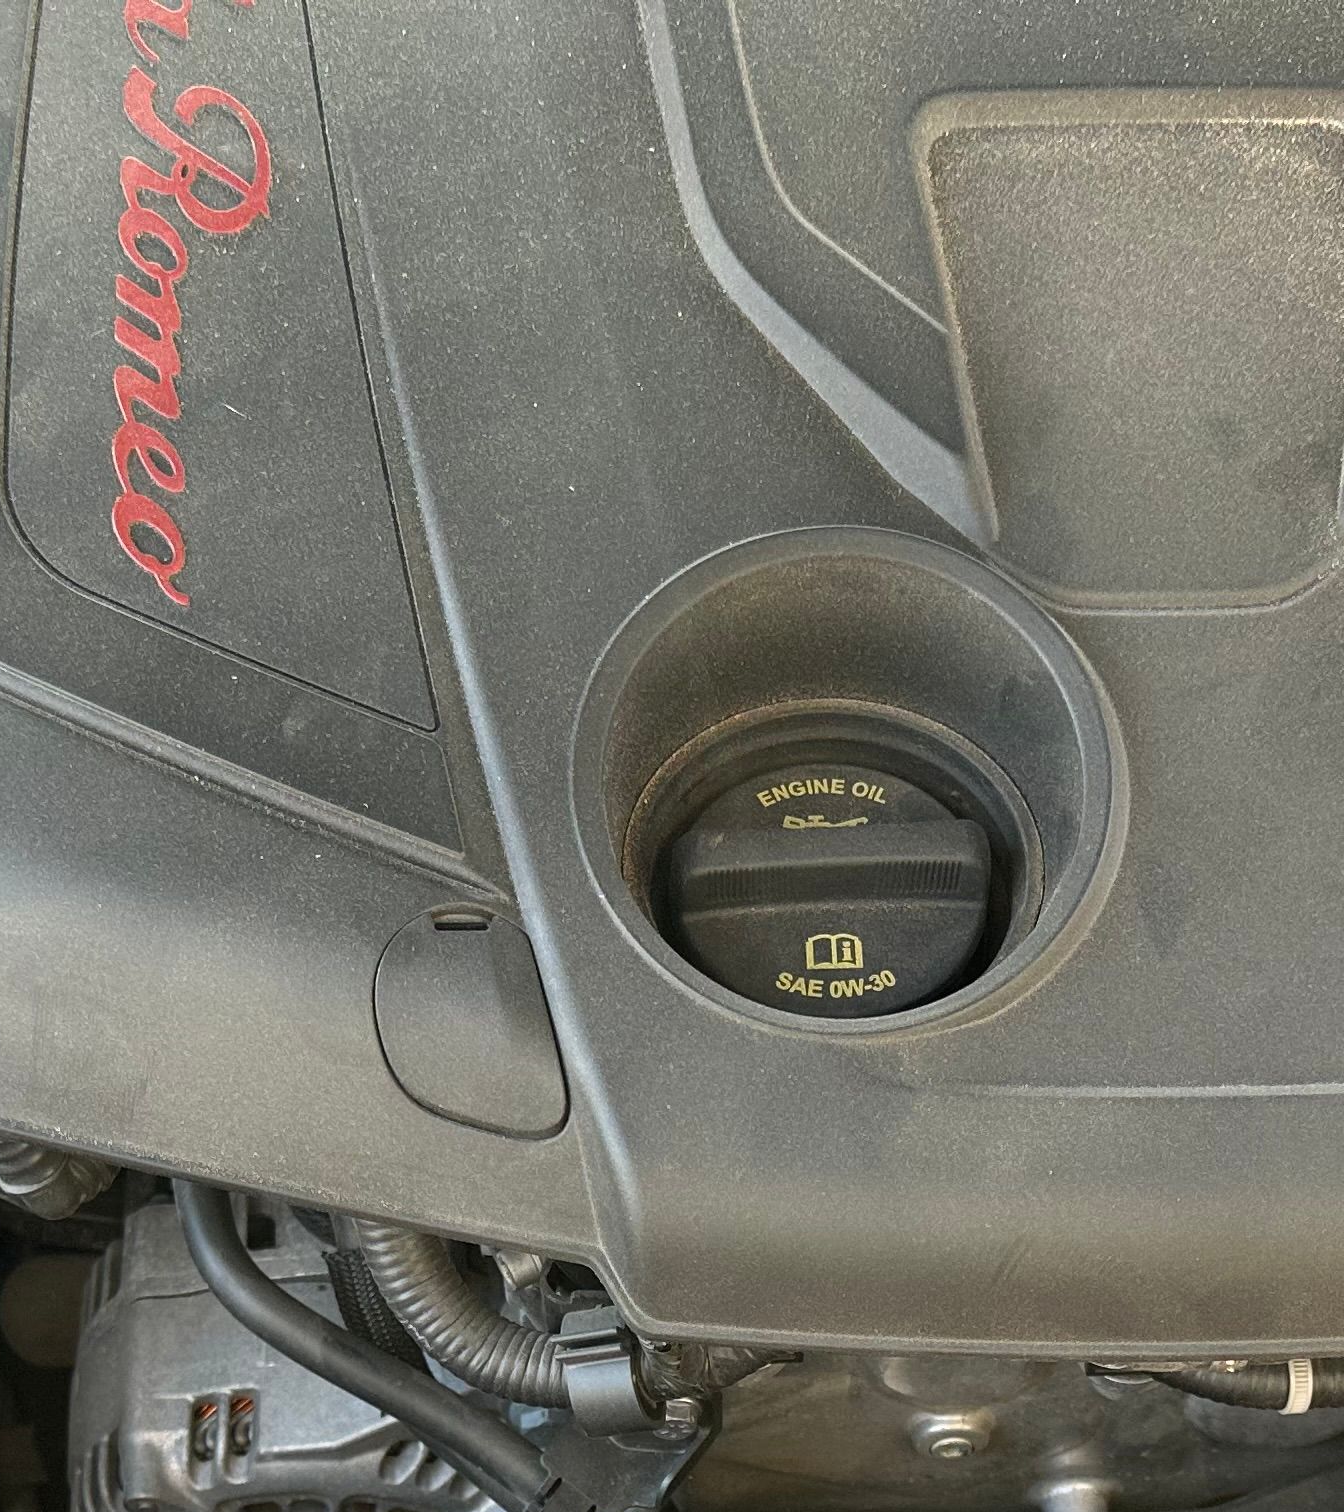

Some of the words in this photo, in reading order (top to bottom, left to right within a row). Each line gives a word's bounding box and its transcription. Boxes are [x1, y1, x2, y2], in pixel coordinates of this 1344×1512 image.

[111, 65, 272, 607] Romeo
[757, 778, 845, 808] ENGINE
[851, 782, 886, 805] OIL
[775, 972, 824, 998] SAE
[829, 969, 897, 999] 0W-30
